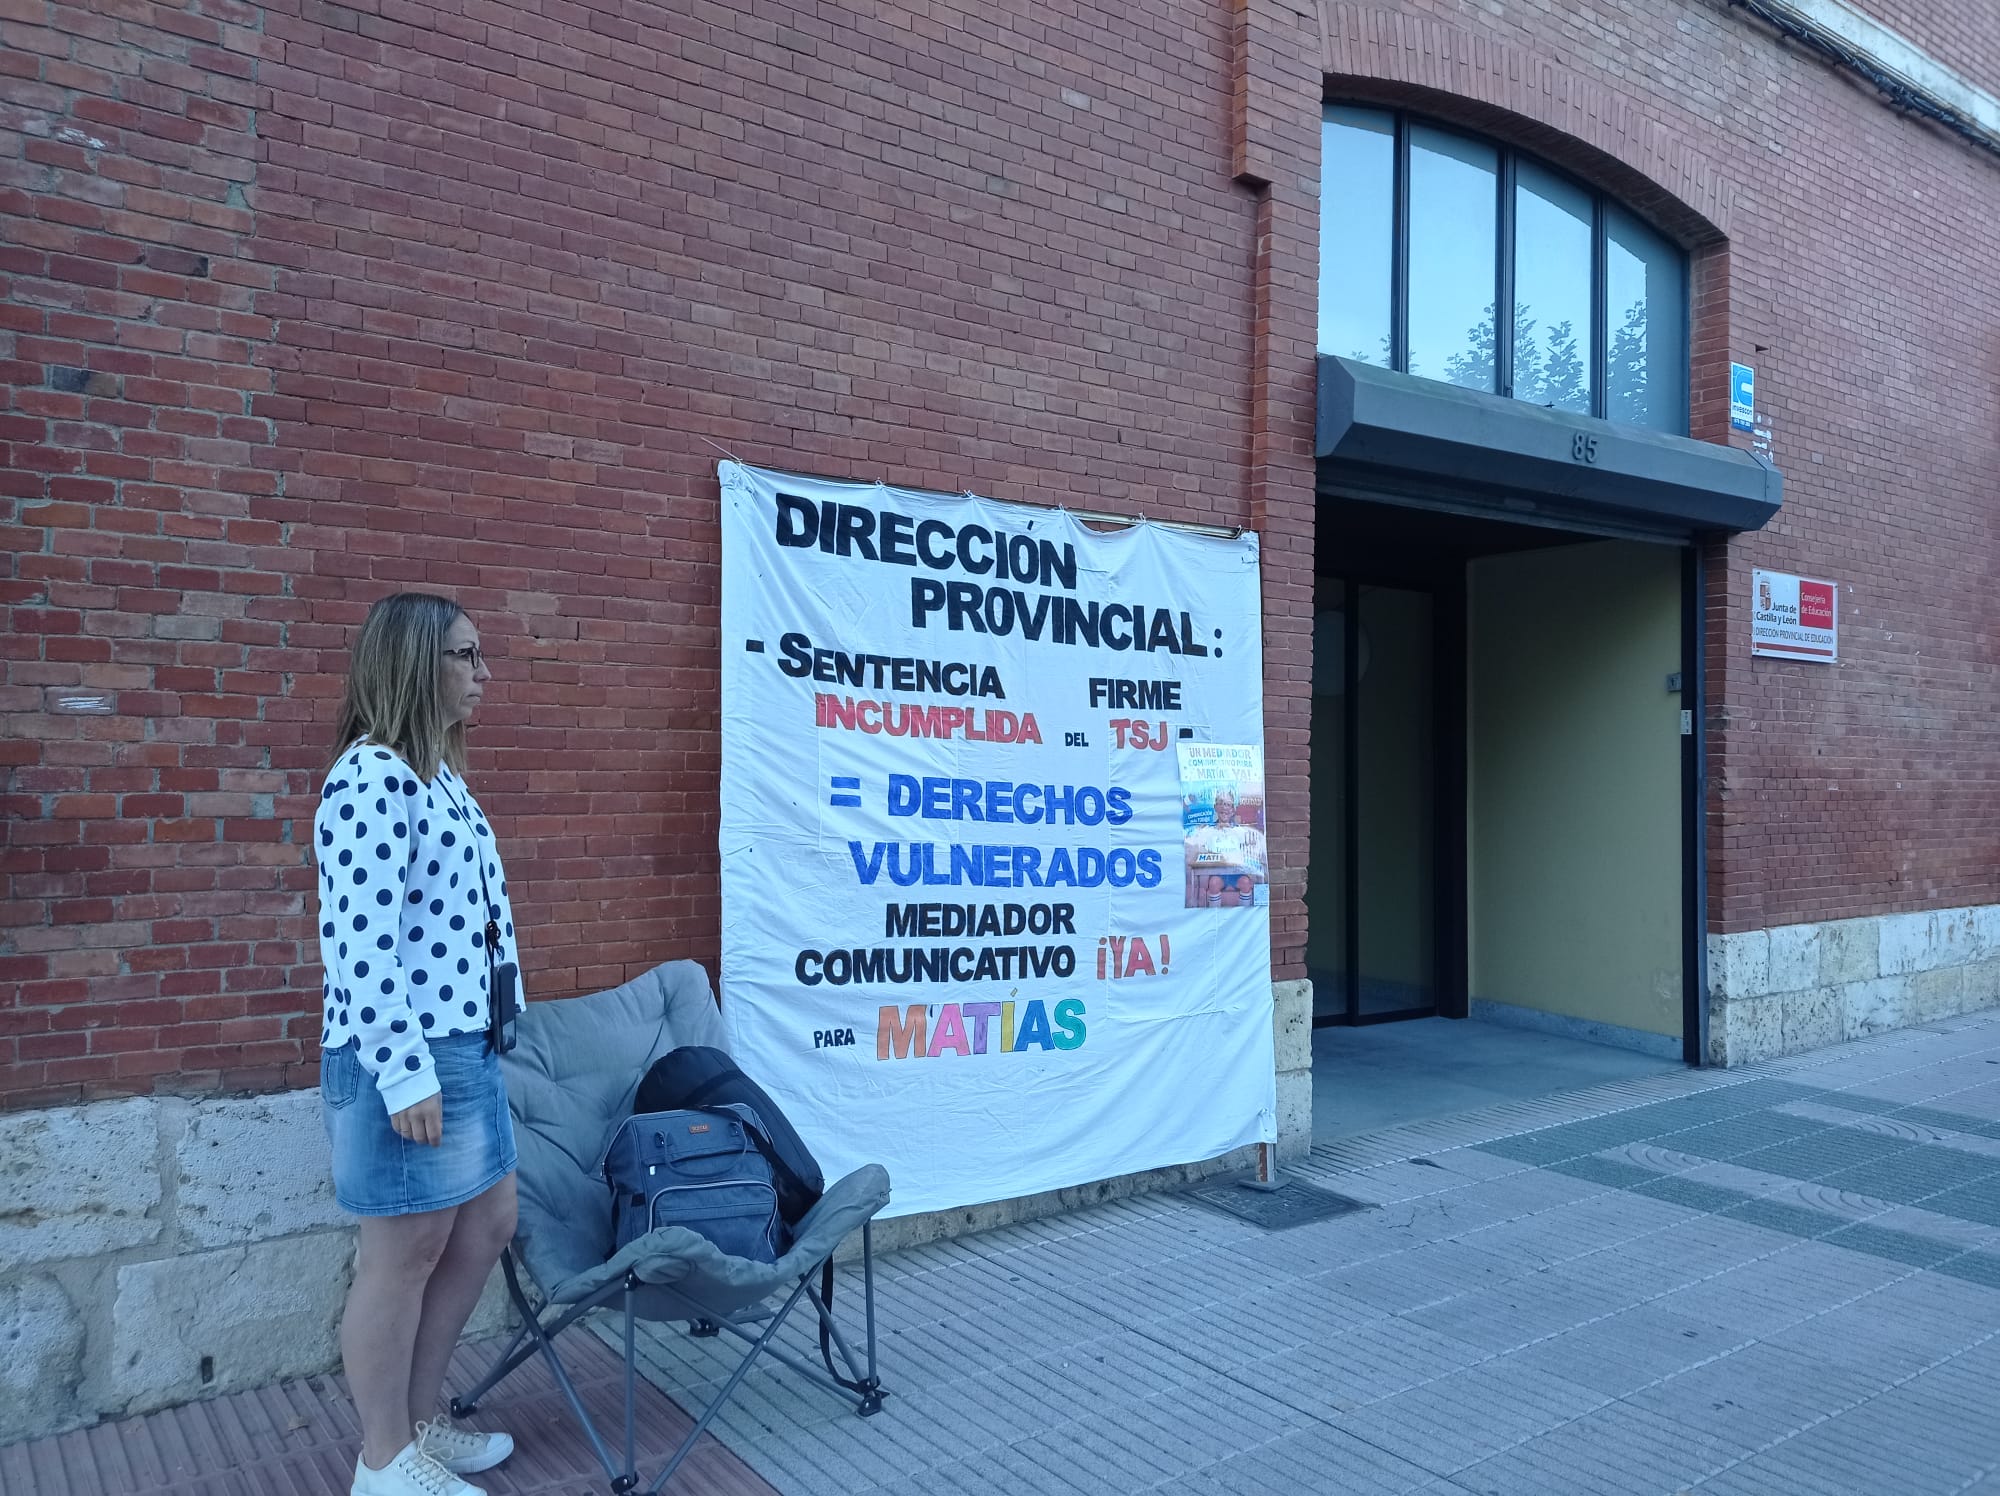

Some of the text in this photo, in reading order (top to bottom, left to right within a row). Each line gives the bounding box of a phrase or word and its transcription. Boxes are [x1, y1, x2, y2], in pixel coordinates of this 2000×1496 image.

[1572, 432, 1597, 464] 85
[775, 492, 1077, 591] DIRECCIÓN
[1771, 602, 1797, 614] Junta de
[1801, 592, 1826, 605] Consejería
[1801, 605, 1832, 617] de Educación
[1756, 611, 1777, 623] Castilla
[1782, 615, 1797, 625] León
[1780, 628, 1804, 641] PROVINCIAL
[1804, 632, 1811, 642] DE
[1089, 678, 1182, 711] FIRME
[815, 692, 1043, 745] INCUMPLIDA
[1065, 731, 1089, 748] DEL
[1202, 747, 1252, 760] MEDIADOR
[1196, 766, 1229, 779] MATÍA
[887, 773, 1133, 826] DERECHOS
[847, 840, 1162, 889] VULNERADOS
[886, 902, 1077, 938] MEDIADOR
[794, 934, 1171, 987] COMUNICATIVO ¡YA!
[814, 988, 1087, 1061] PARA MATÍAS
